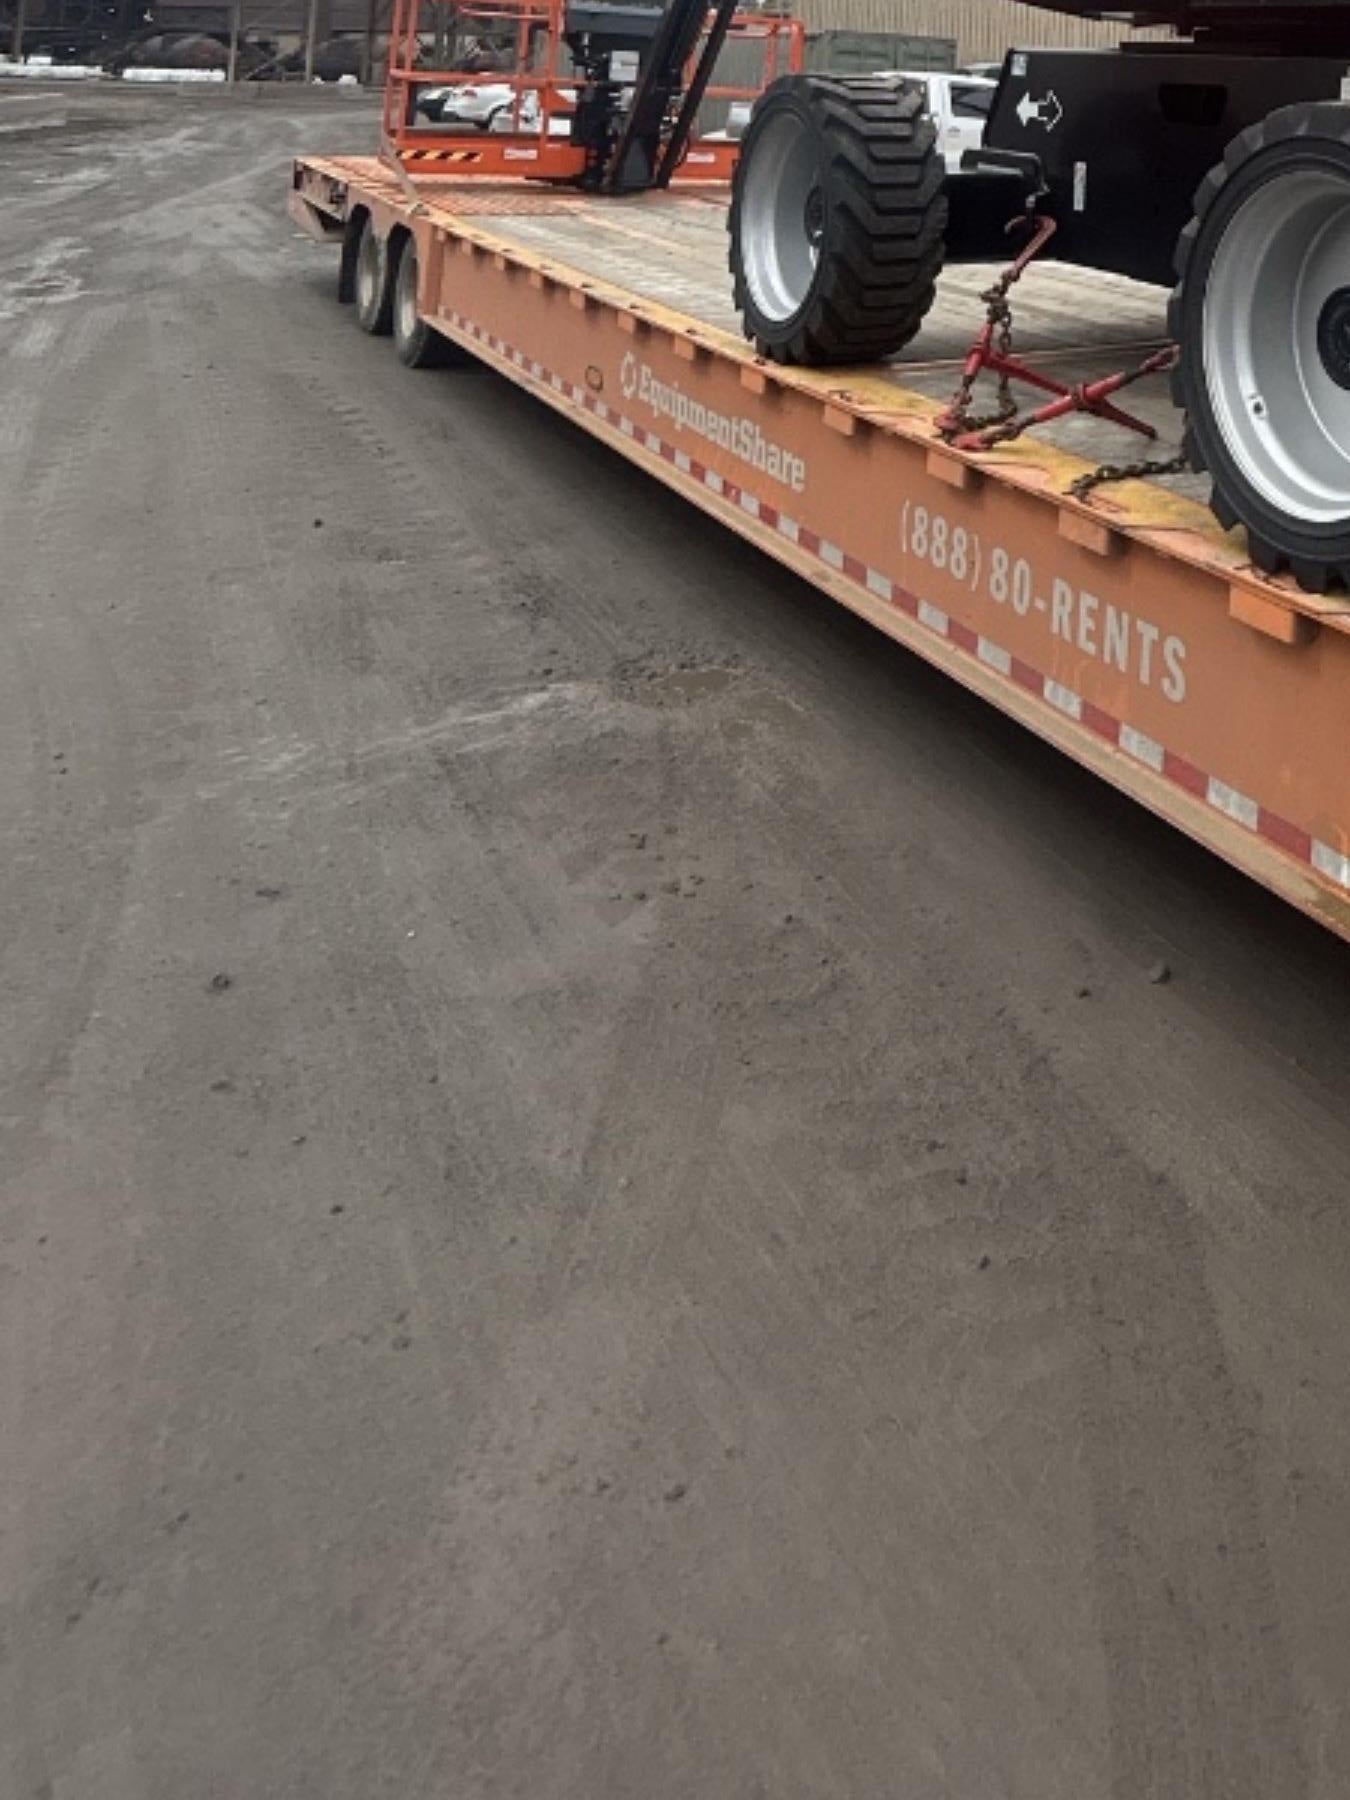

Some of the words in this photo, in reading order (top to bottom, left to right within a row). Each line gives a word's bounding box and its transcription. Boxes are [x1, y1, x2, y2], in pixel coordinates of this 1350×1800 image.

[638, 363, 806, 494] EquipmentShare
[902, 499, 982, 592] (888)
[989, 547, 1187, 703] 80-RENTS
